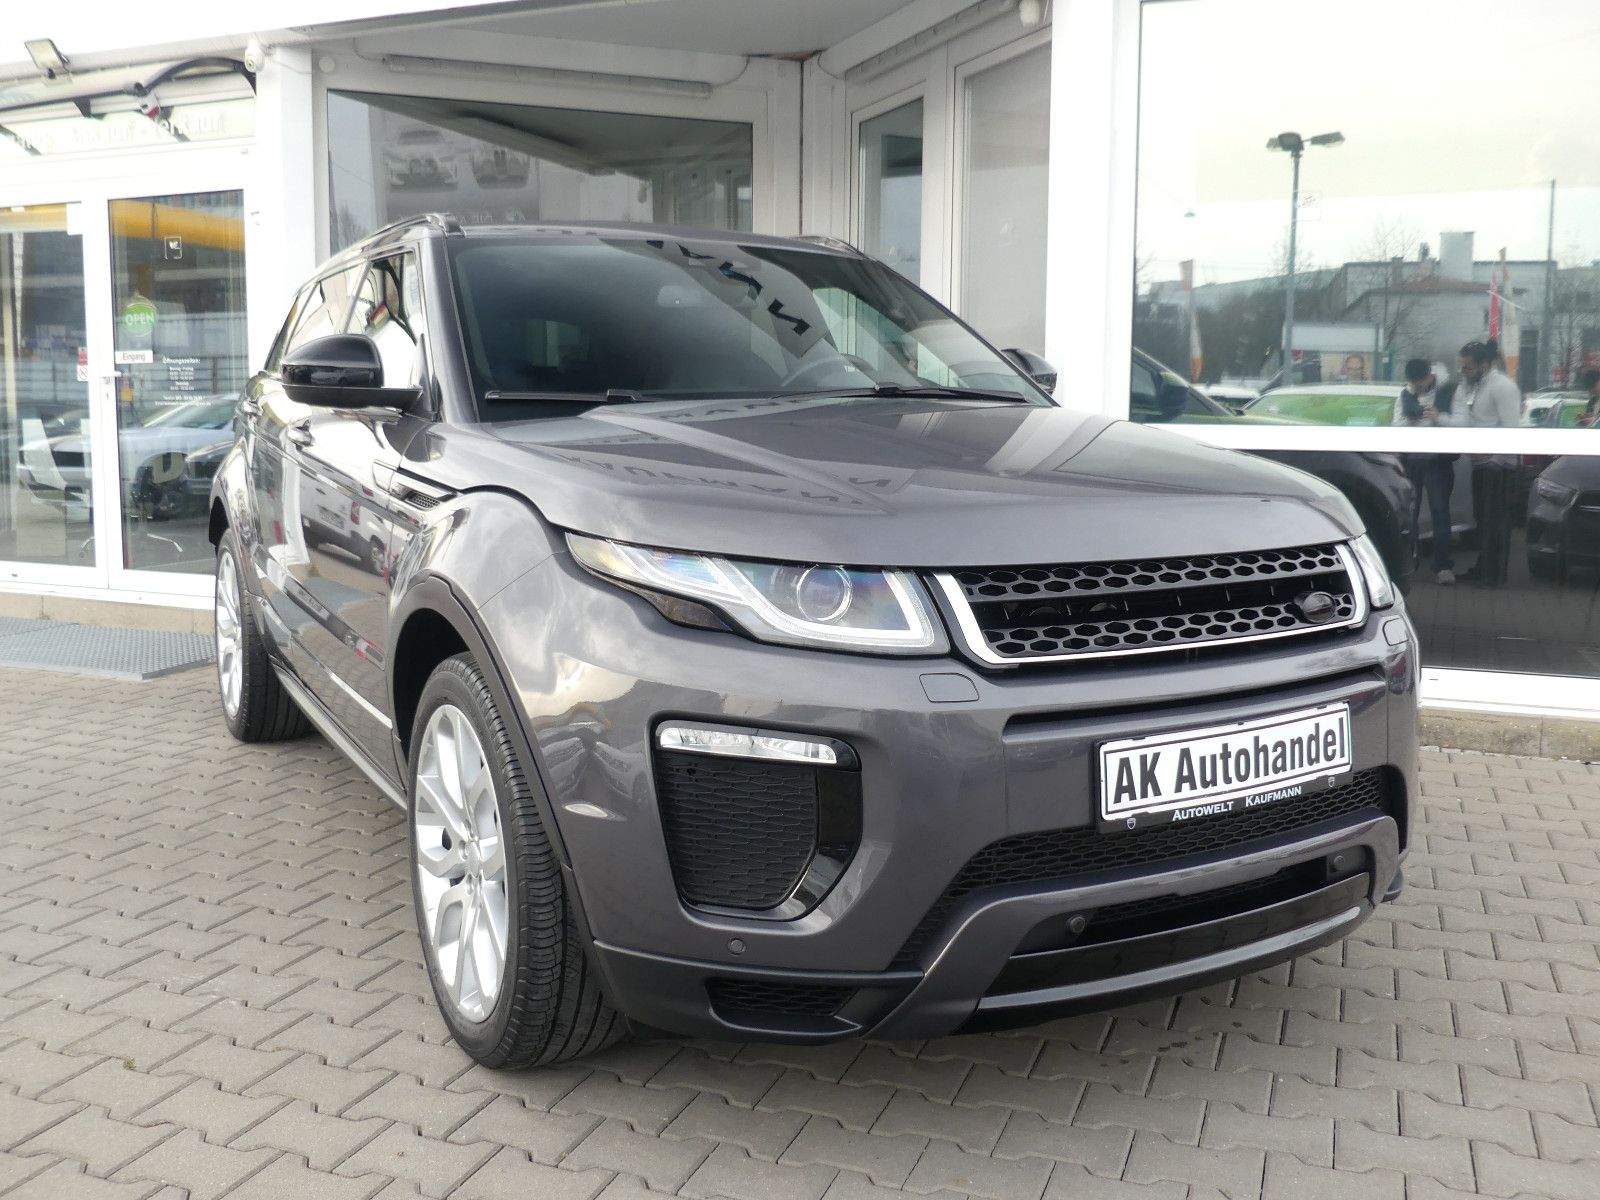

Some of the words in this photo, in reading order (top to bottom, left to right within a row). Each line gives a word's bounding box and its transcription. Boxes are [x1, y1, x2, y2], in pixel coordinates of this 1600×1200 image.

[125, 312, 154, 326] OPEN
[1113, 751, 1162, 804] AK
[1174, 717, 1345, 793] Autohandel
[1172, 800, 1234, 822] AUTOWELT
[1245, 787, 1302, 807] KAUFMANN
